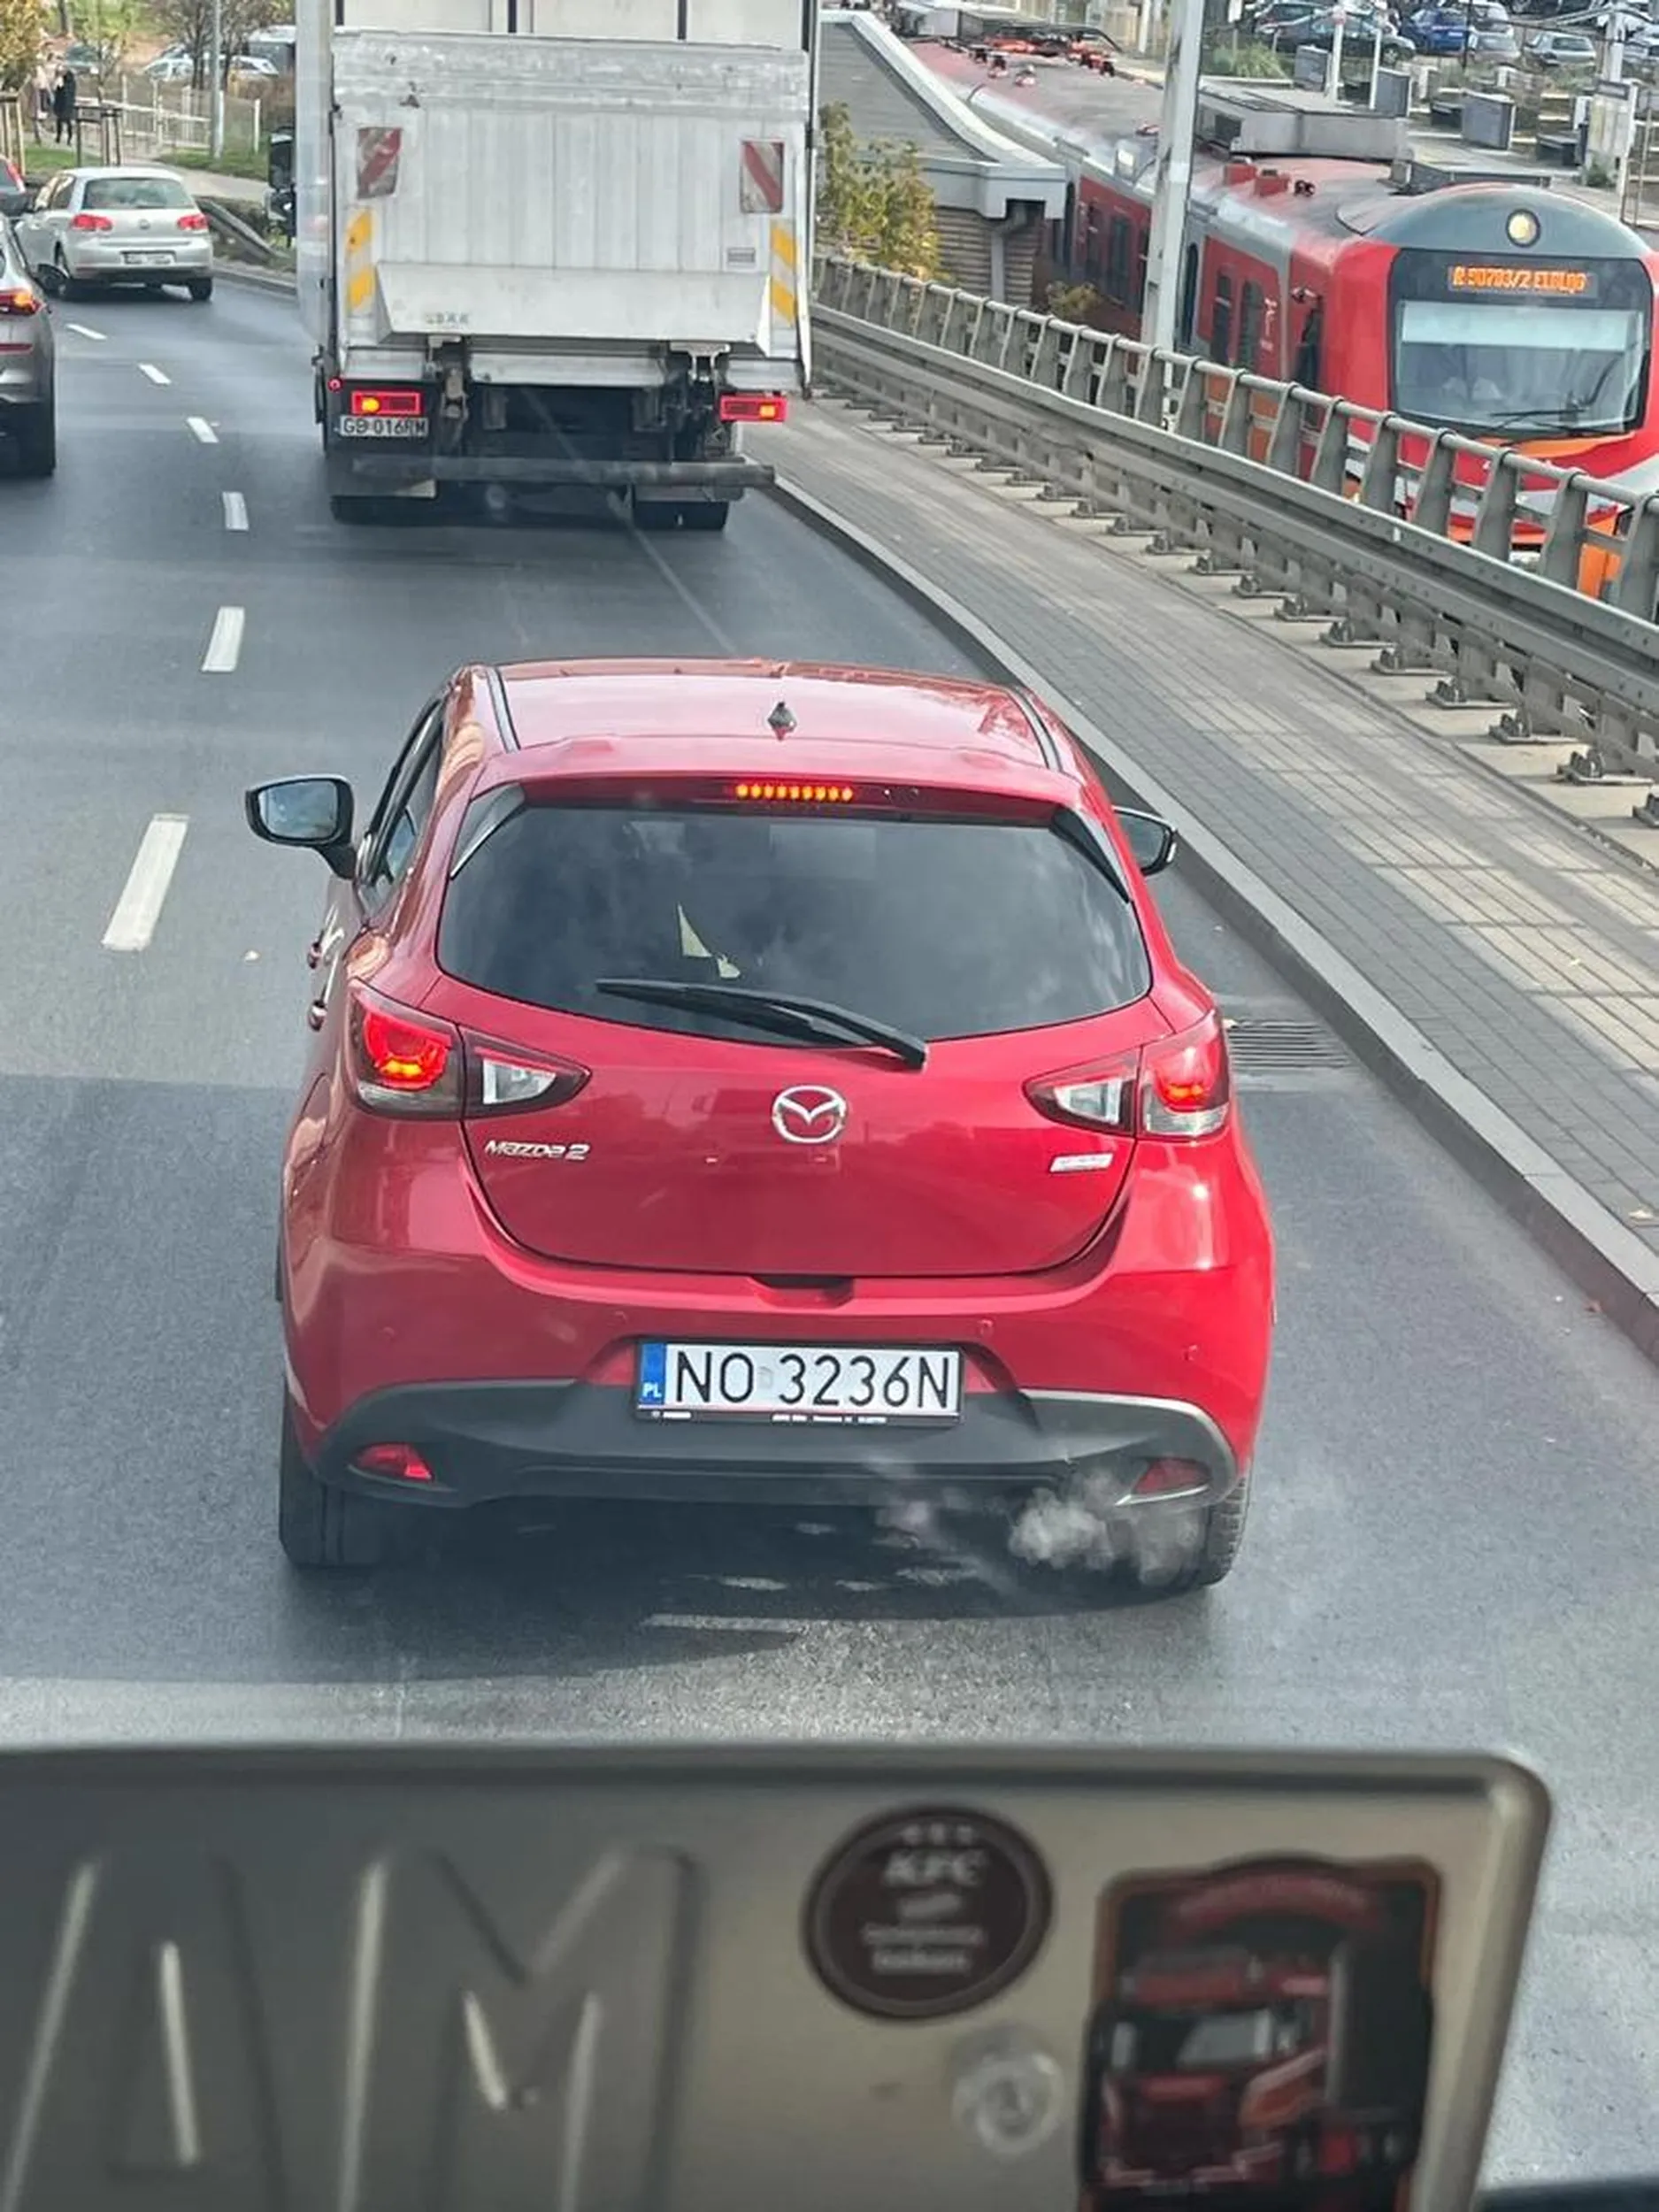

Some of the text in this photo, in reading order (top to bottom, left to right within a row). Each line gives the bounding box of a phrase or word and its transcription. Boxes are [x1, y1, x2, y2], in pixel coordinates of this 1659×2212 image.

[642, 1381, 663, 1398] PL
[675, 1350, 949, 1409] NO 3236N
